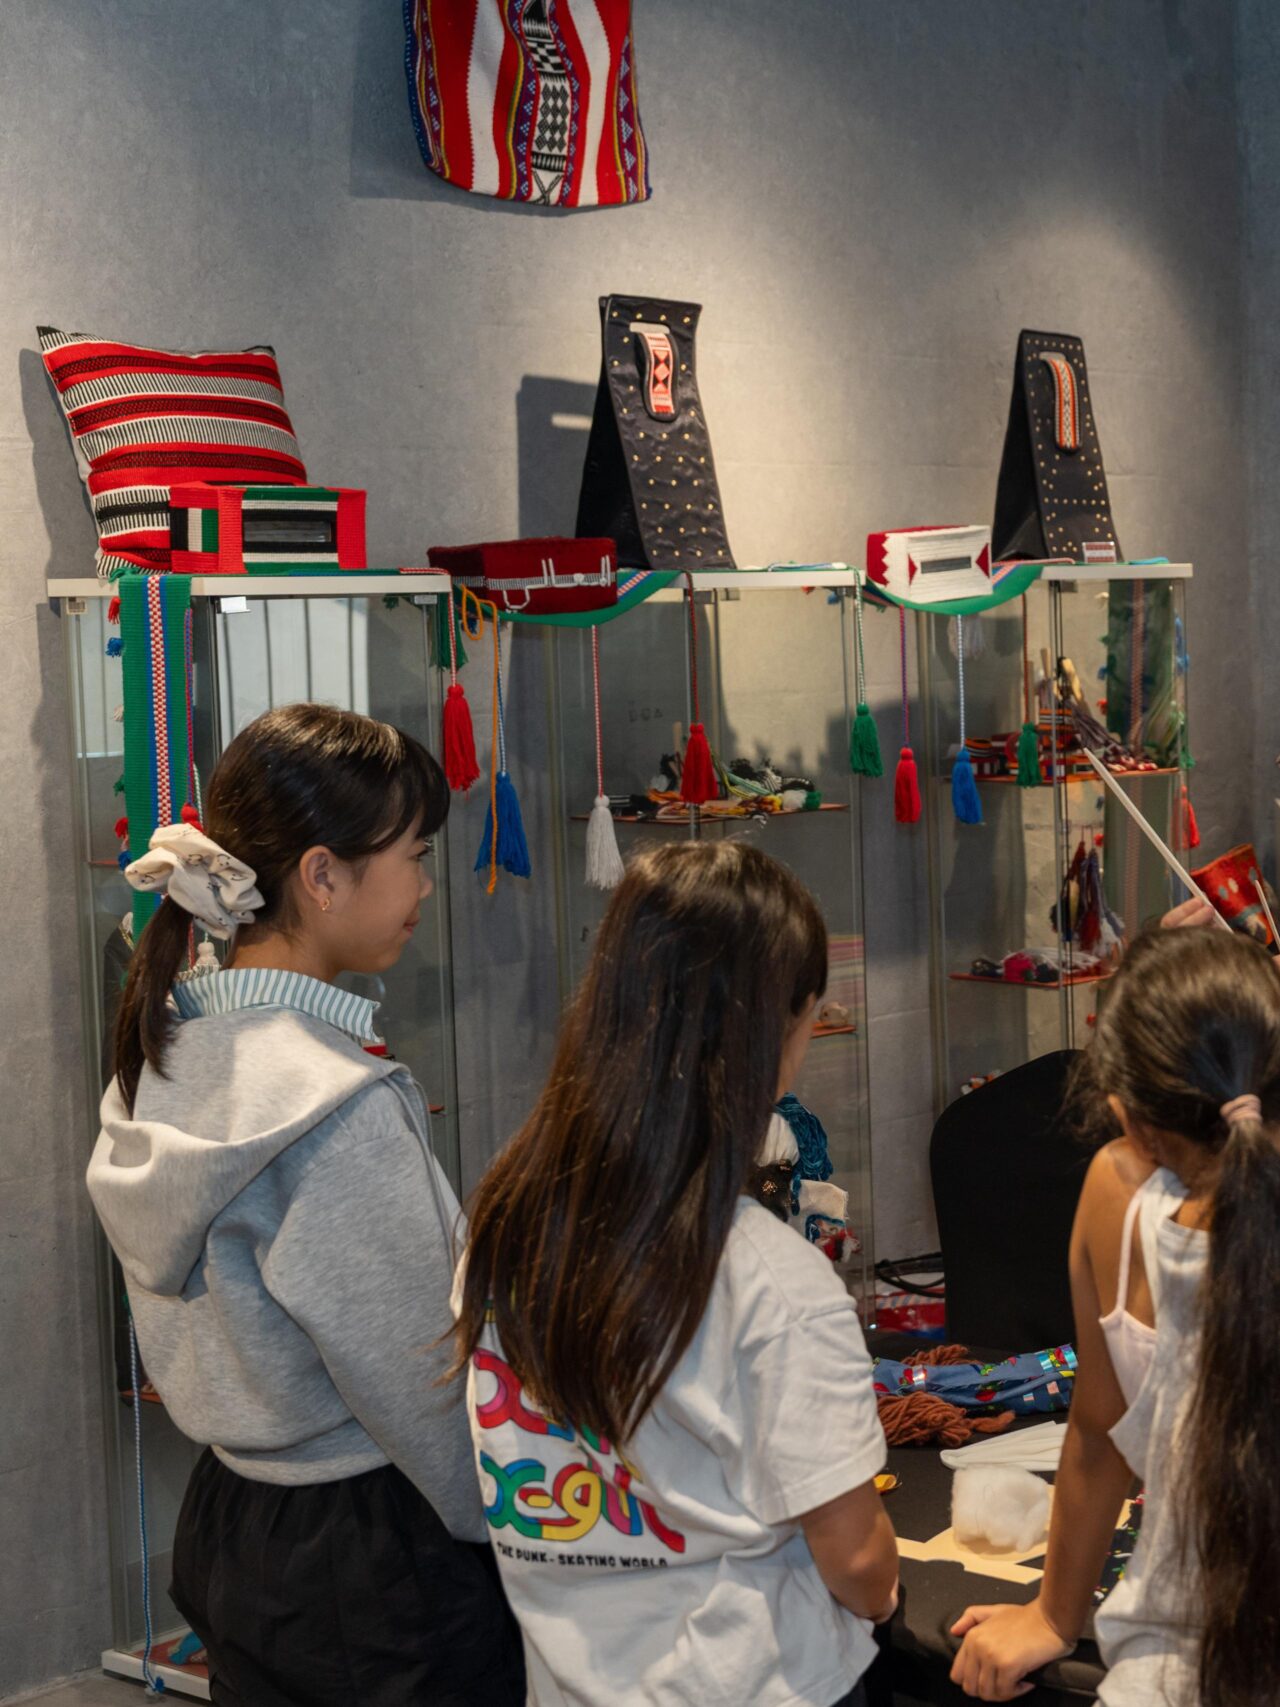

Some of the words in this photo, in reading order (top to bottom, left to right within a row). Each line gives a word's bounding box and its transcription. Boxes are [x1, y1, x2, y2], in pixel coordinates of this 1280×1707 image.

[496, 1541, 514, 1558] THE
[557, 1554, 617, 1567] SKATING
[619, 1555, 668, 1568] WORLD
